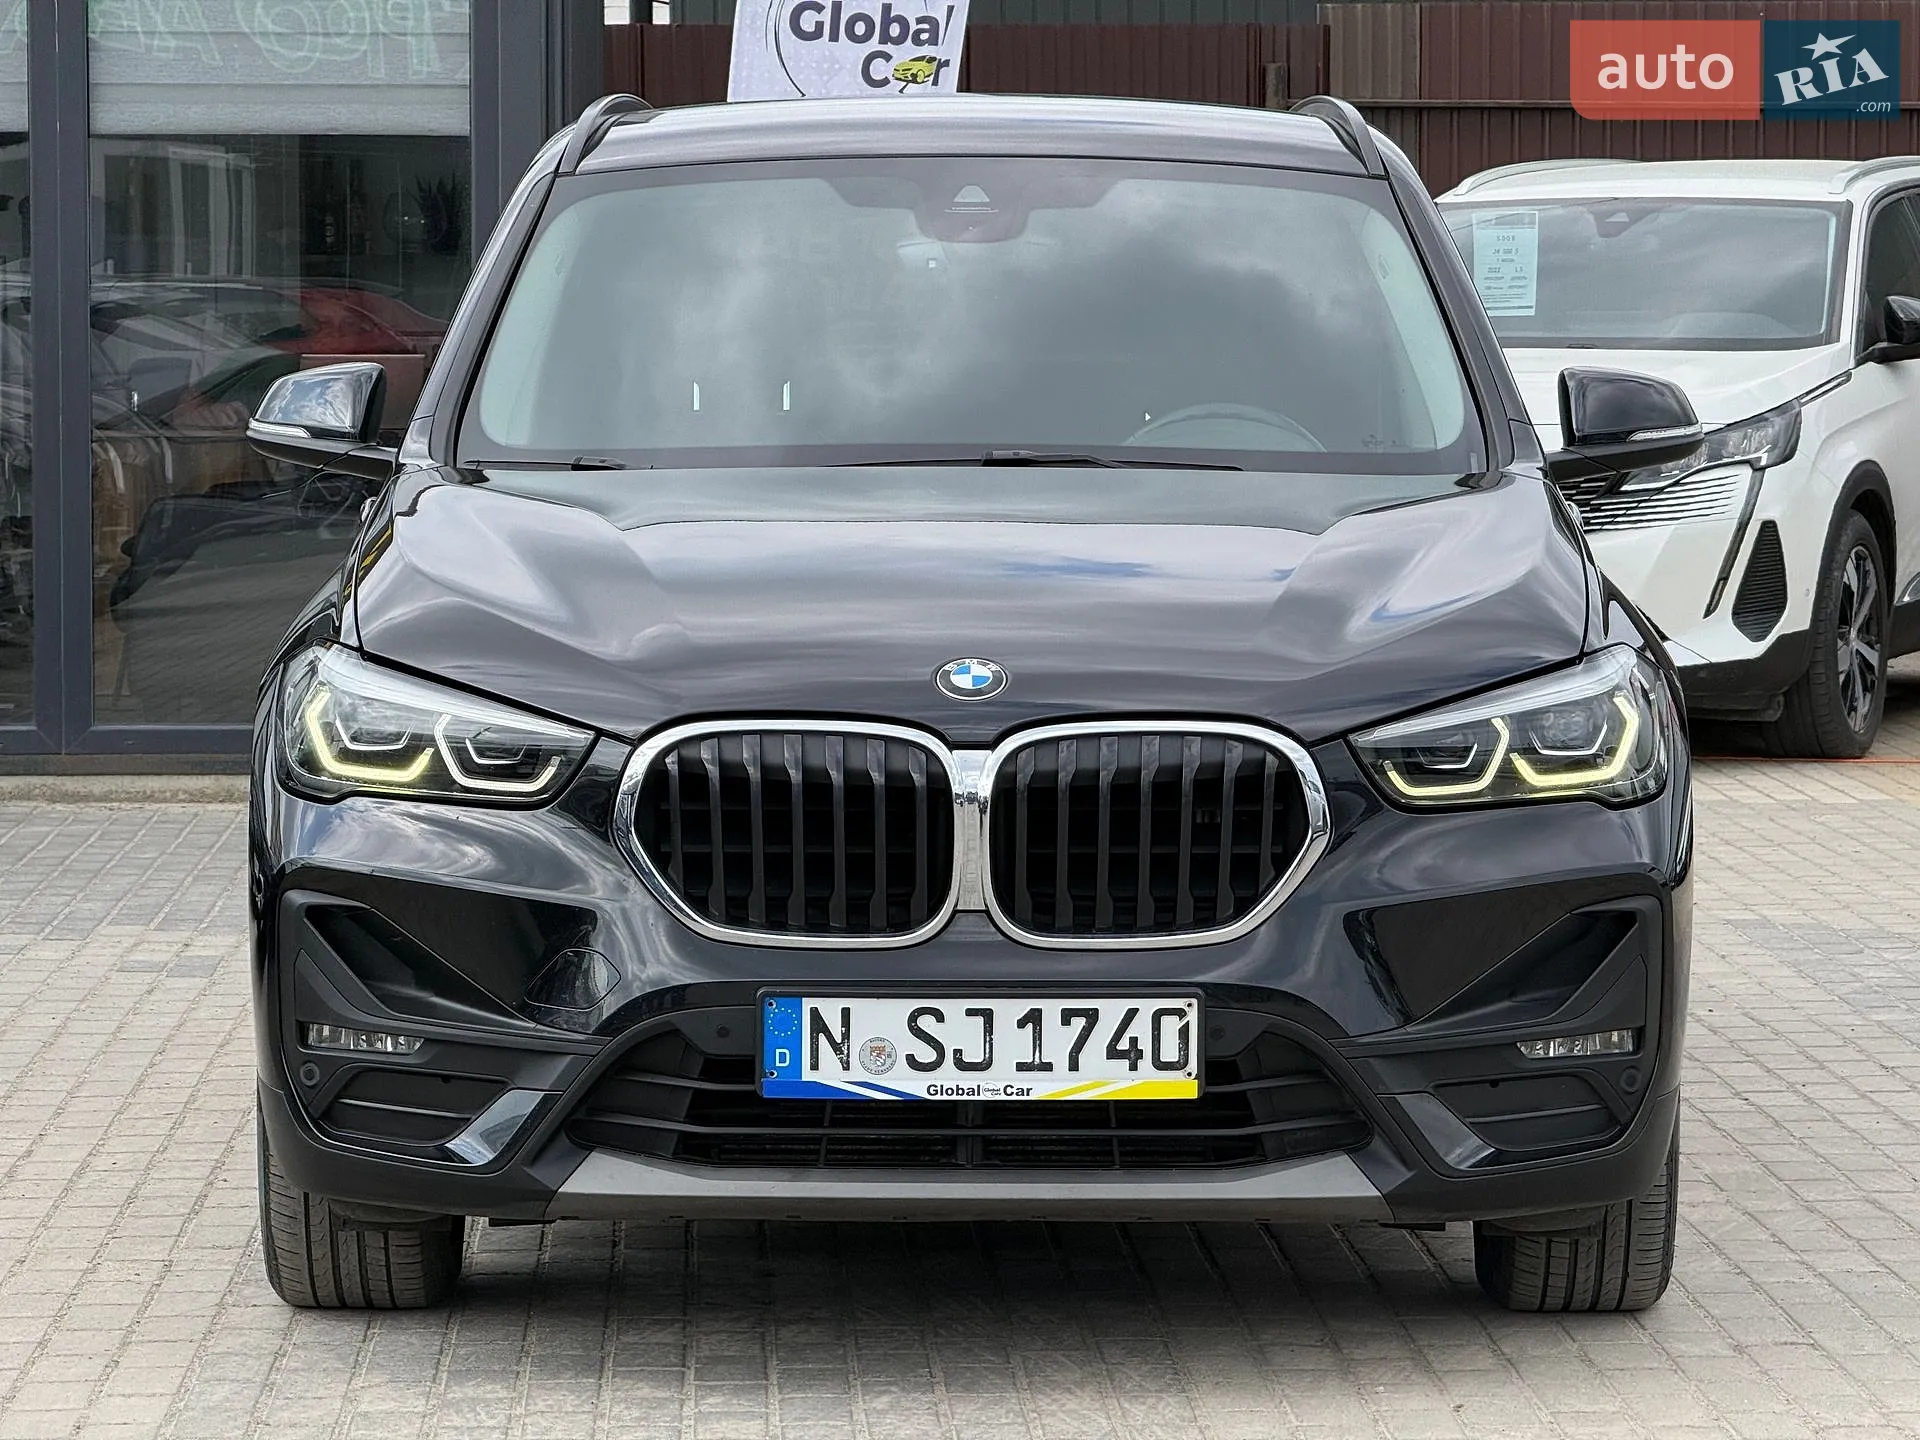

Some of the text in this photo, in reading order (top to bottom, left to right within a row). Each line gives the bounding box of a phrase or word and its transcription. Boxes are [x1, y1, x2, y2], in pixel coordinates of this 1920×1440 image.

[788, 0, 955, 47] Global
[861, 50, 951, 89] Cr
[775, 1048, 790, 1067] D
[809, 1006, 1190, 1073] N SJ 1740
[926, 1084, 1033, 1097] Global Car
